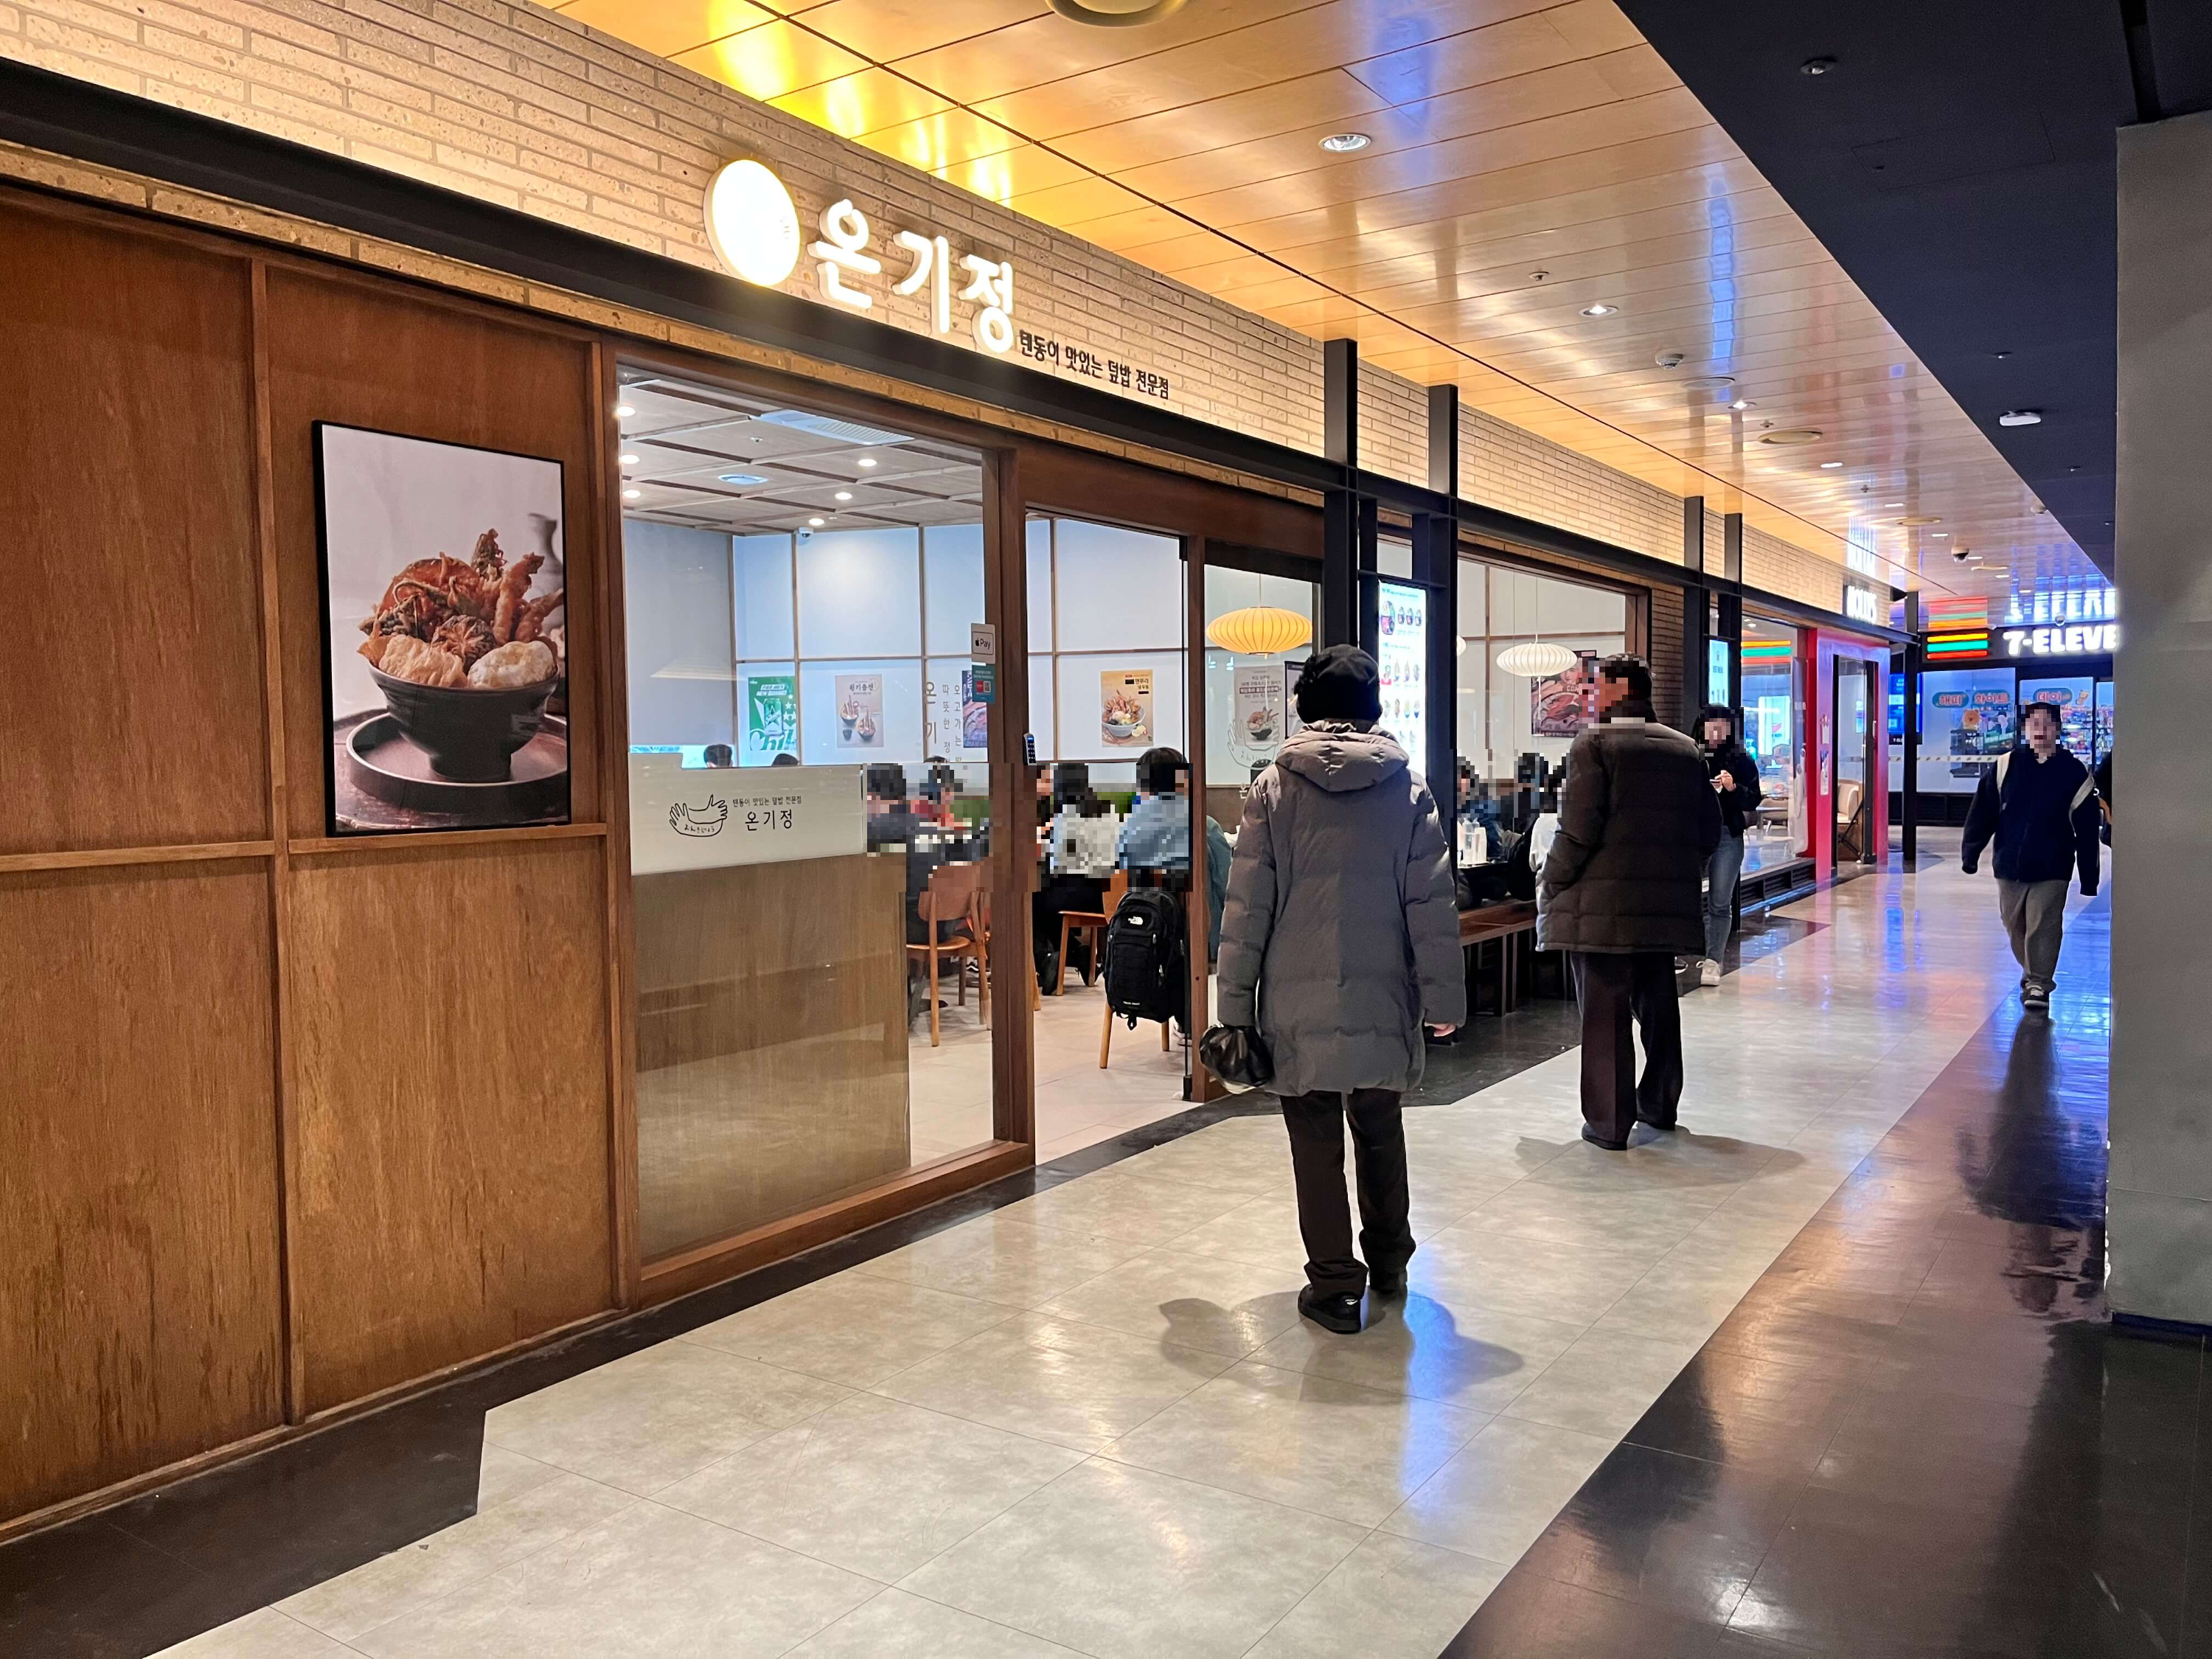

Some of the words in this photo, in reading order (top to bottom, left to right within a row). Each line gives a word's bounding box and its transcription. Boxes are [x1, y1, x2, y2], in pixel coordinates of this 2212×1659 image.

[807, 198, 1015, 354] 온기정
[1019, 329, 1060, 366] 텐동이
[1065, 345, 1103, 380] 맛있는
[1108, 359, 1132, 389] 덮밥
[1135, 369, 1169, 400] 전문점
[980, 639, 991, 650] Pay
[1939, 695, 1962, 706] 해피
[1975, 692, 2008, 706] 화이트
[2037, 691, 2062, 703] 데이
[732, 798, 751, 808] 텐동이
[753, 797, 770, 807] 맛있는
[785, 796, 802, 805] 전문점
[745, 809, 793, 832] 온기정
